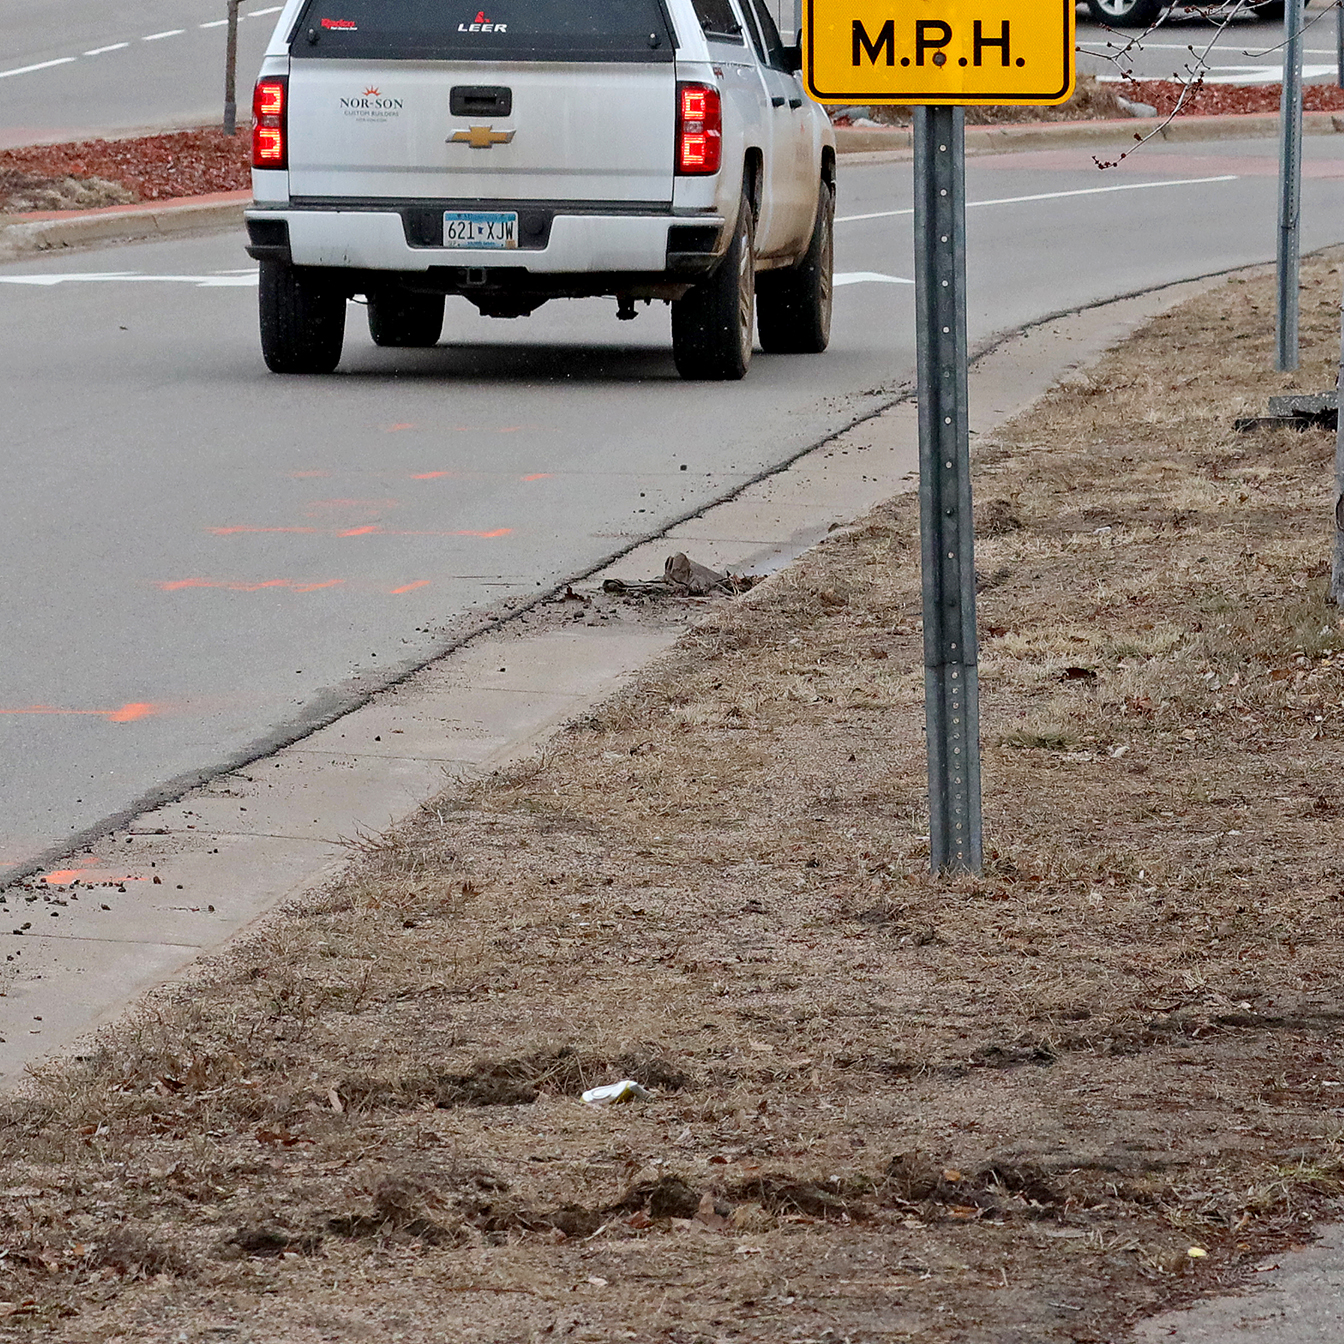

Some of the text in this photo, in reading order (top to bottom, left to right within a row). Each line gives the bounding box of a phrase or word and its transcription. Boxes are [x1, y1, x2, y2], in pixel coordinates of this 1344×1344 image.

[457, 23, 508, 33] LEER
[851, 19, 1026, 68] M.P.H.
[340, 97, 404, 109] NOR-SON
[448, 221, 514, 241] 621 XJW
